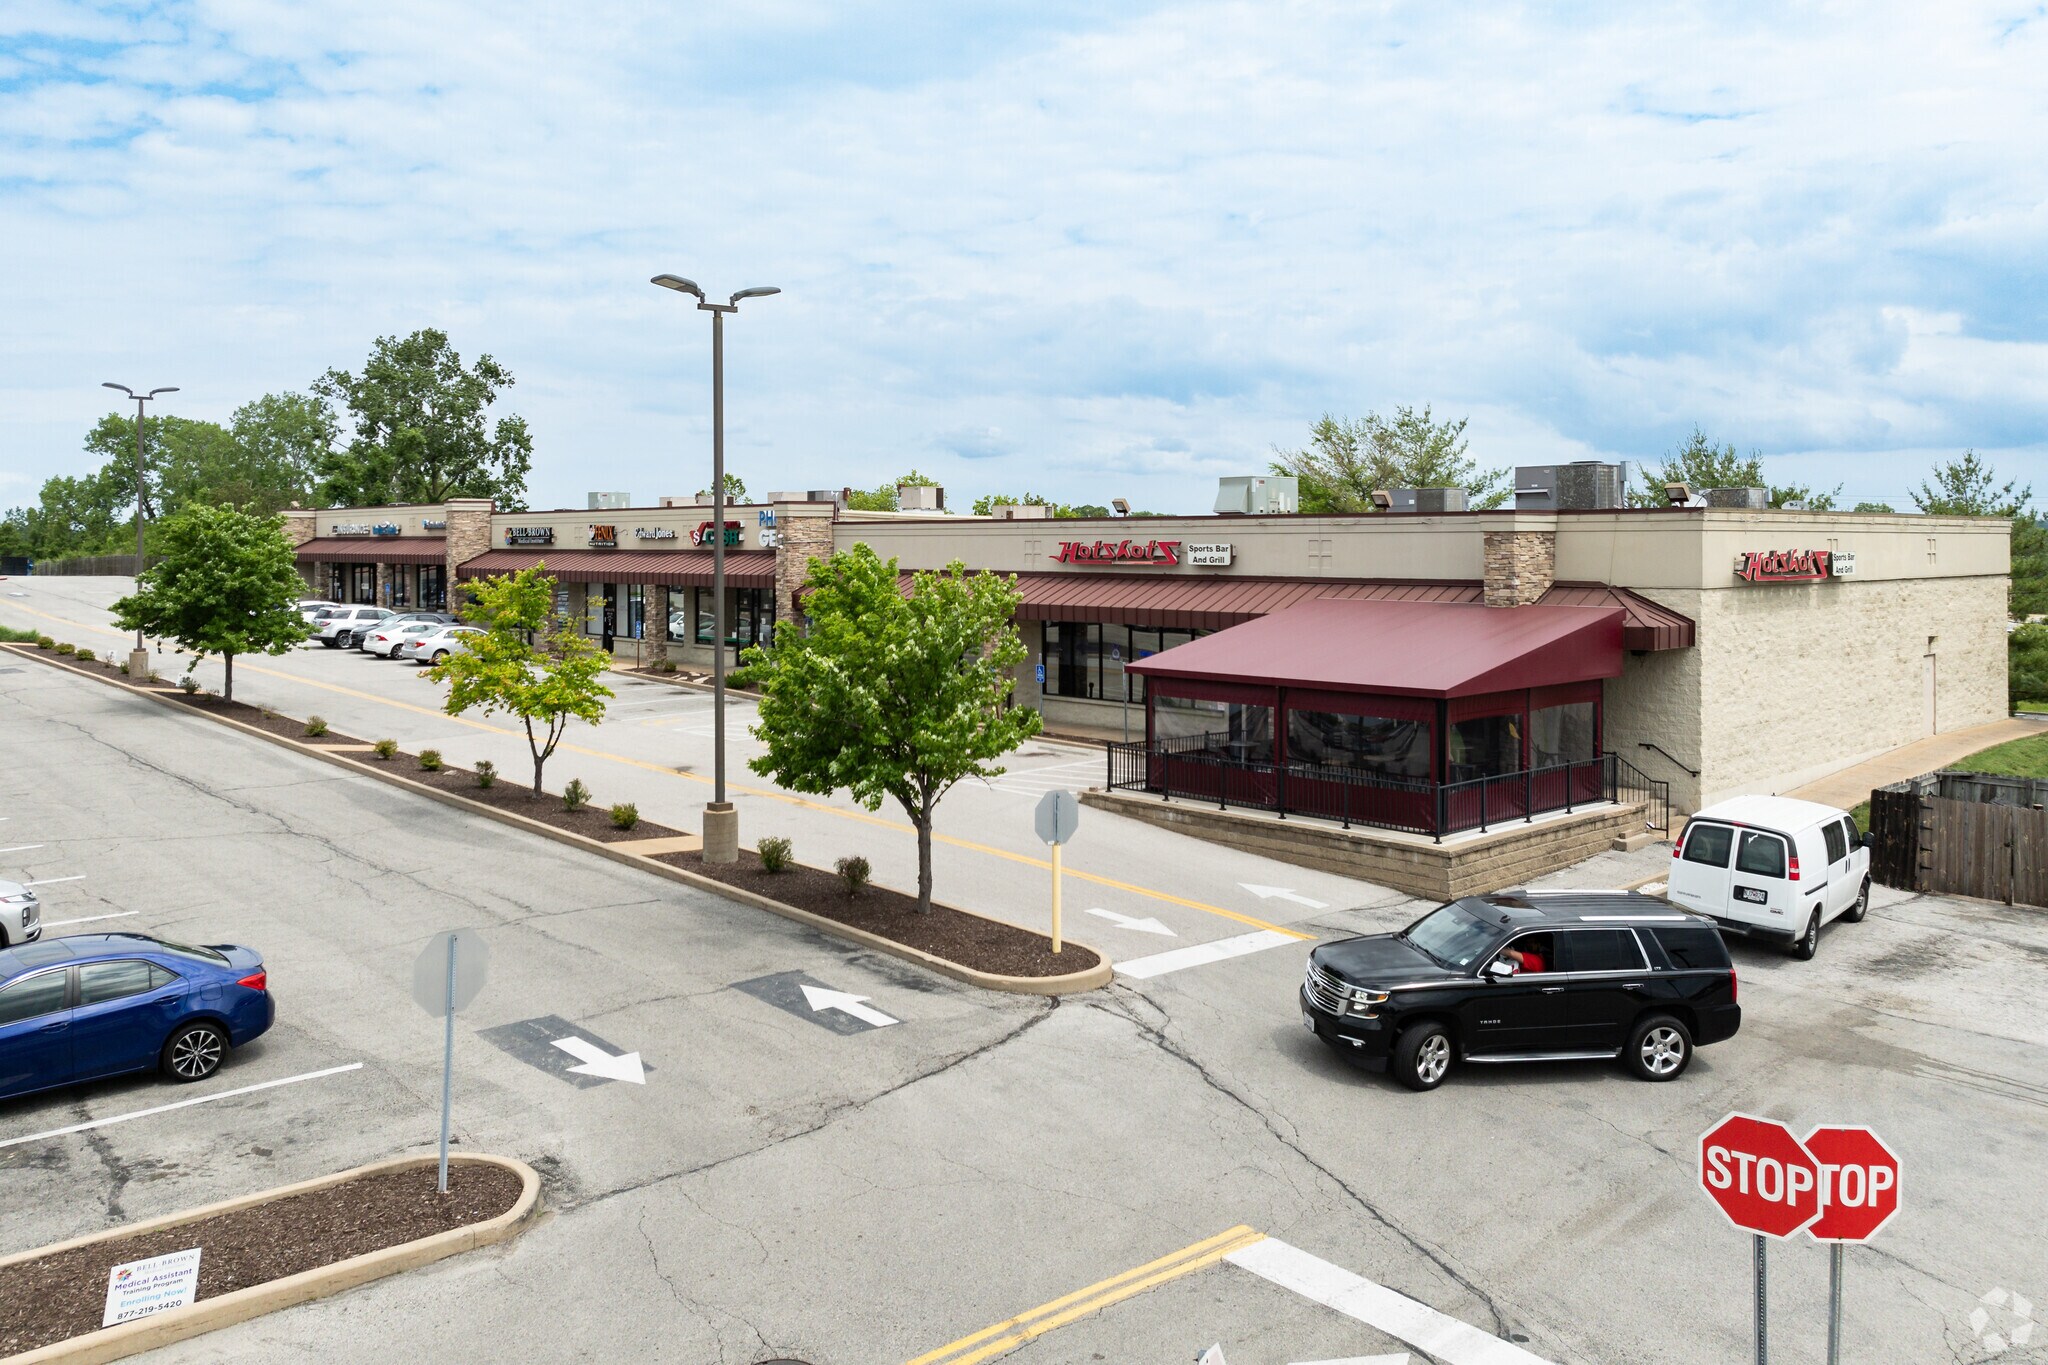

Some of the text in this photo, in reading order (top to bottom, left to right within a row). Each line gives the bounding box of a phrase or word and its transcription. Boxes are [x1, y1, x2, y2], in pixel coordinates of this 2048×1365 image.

[1188, 545, 1229, 553] Sports Bar
[1833, 552, 1855, 562] Sports Bar
[1192, 556, 1225, 564] And Grill
[1845, 565, 1853, 574] Grill
[1707, 1145, 1813, 1207] STOP
[1821, 1164, 1894, 1207] TOP
[114, 1277, 150, 1290] Medical
[151, 1268, 193, 1282] Assistant
[123, 1279, 184, 1296] Training Program
[120, 1286, 188, 1308] Enrolling Now!
[117, 1300, 182, 1320] 877-219-5420
